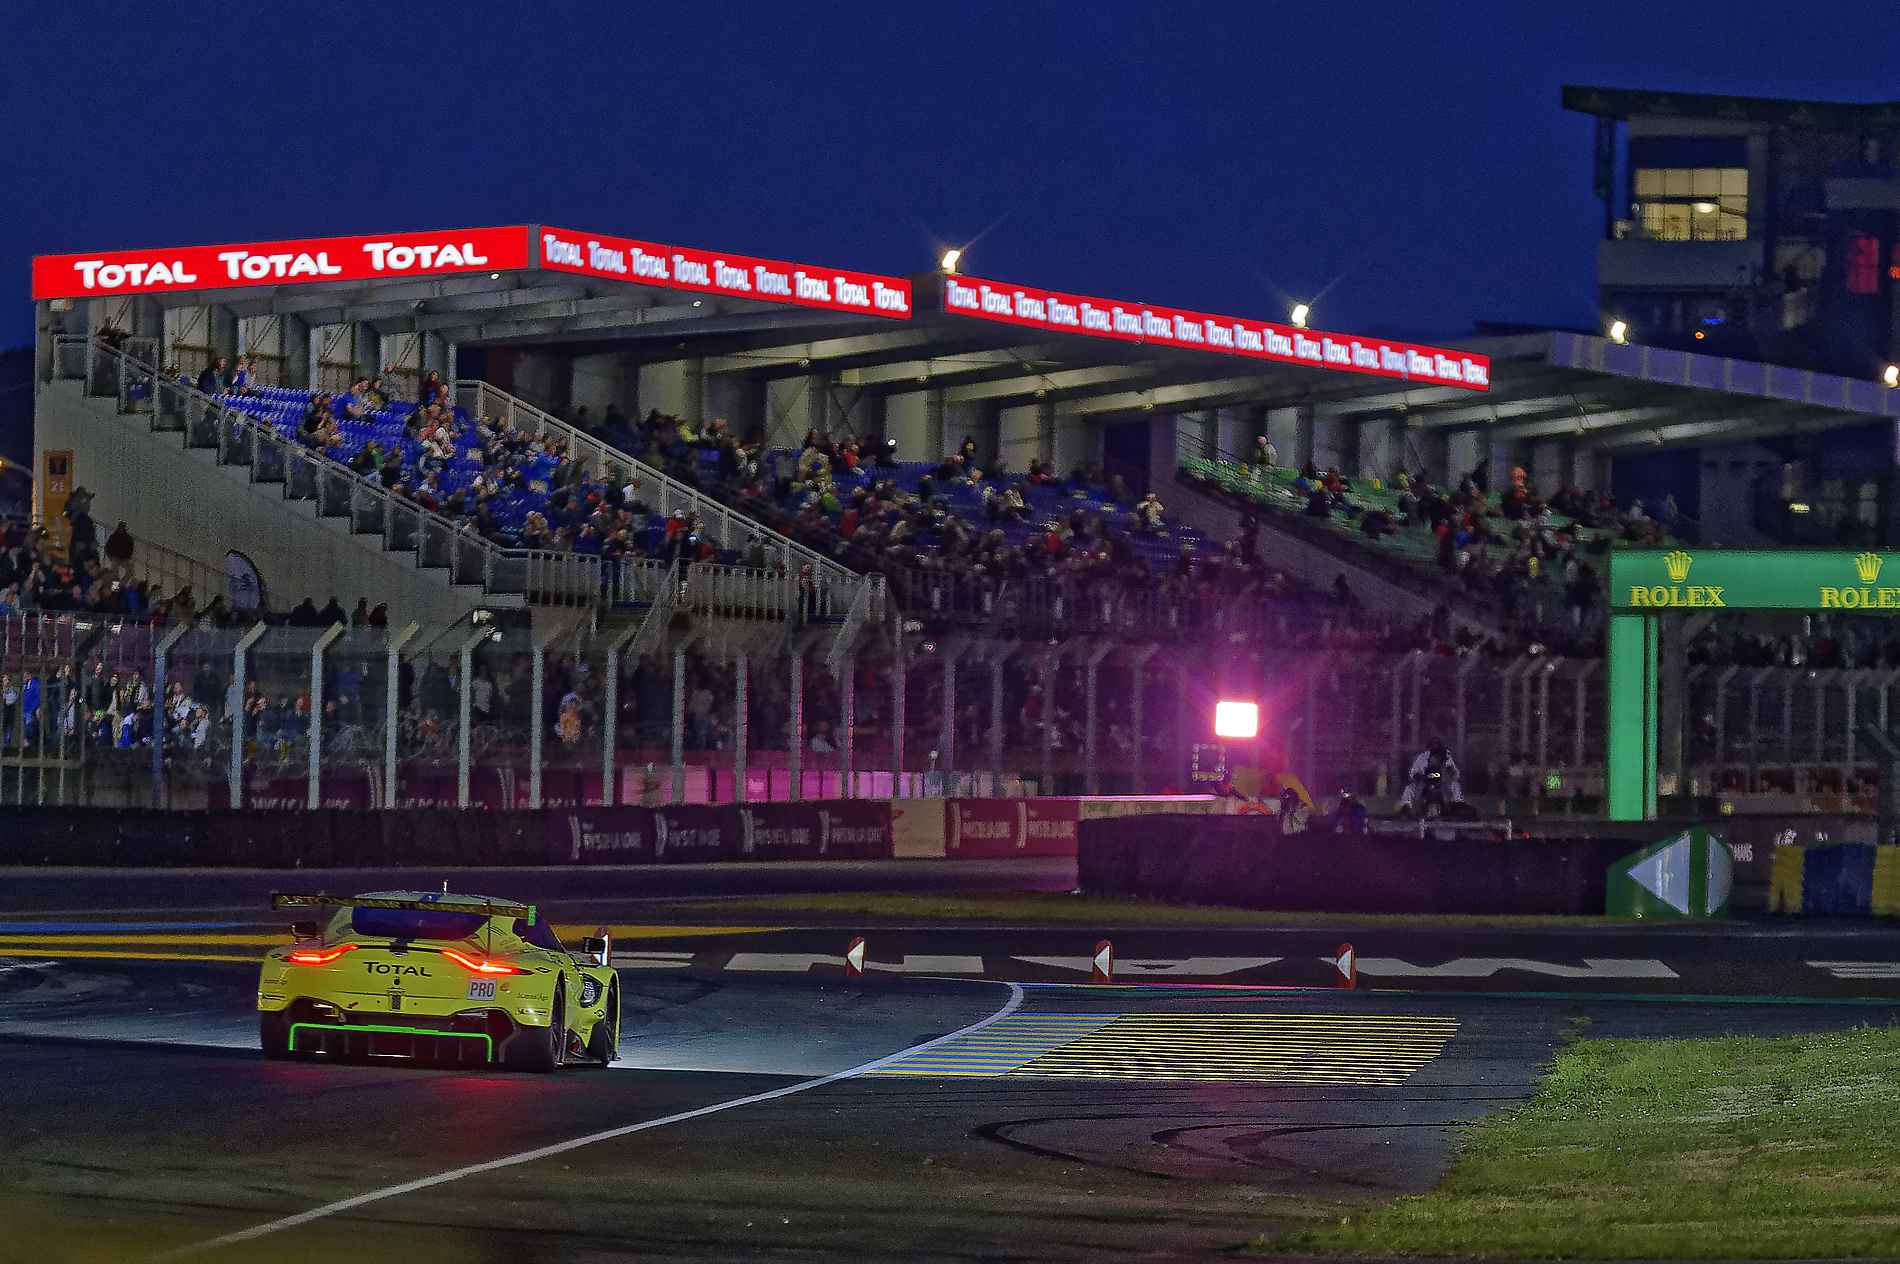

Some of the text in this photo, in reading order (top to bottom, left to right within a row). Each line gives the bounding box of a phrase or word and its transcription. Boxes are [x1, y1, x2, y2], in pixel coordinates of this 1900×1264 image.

[74, 241, 488, 288] TOTAL TOTAL TOTAL
[544, 234, 909, 312] TOTAL TOTAL TOTAL TOTAL TOTAL TOTAL TOTAL TOTAL TOTAL
[1631, 586, 1726, 607] ROLEX
[1820, 587, 1900, 608] ROLE
[363, 961, 432, 977] TOTAL
[470, 982, 495, 998] PRO
